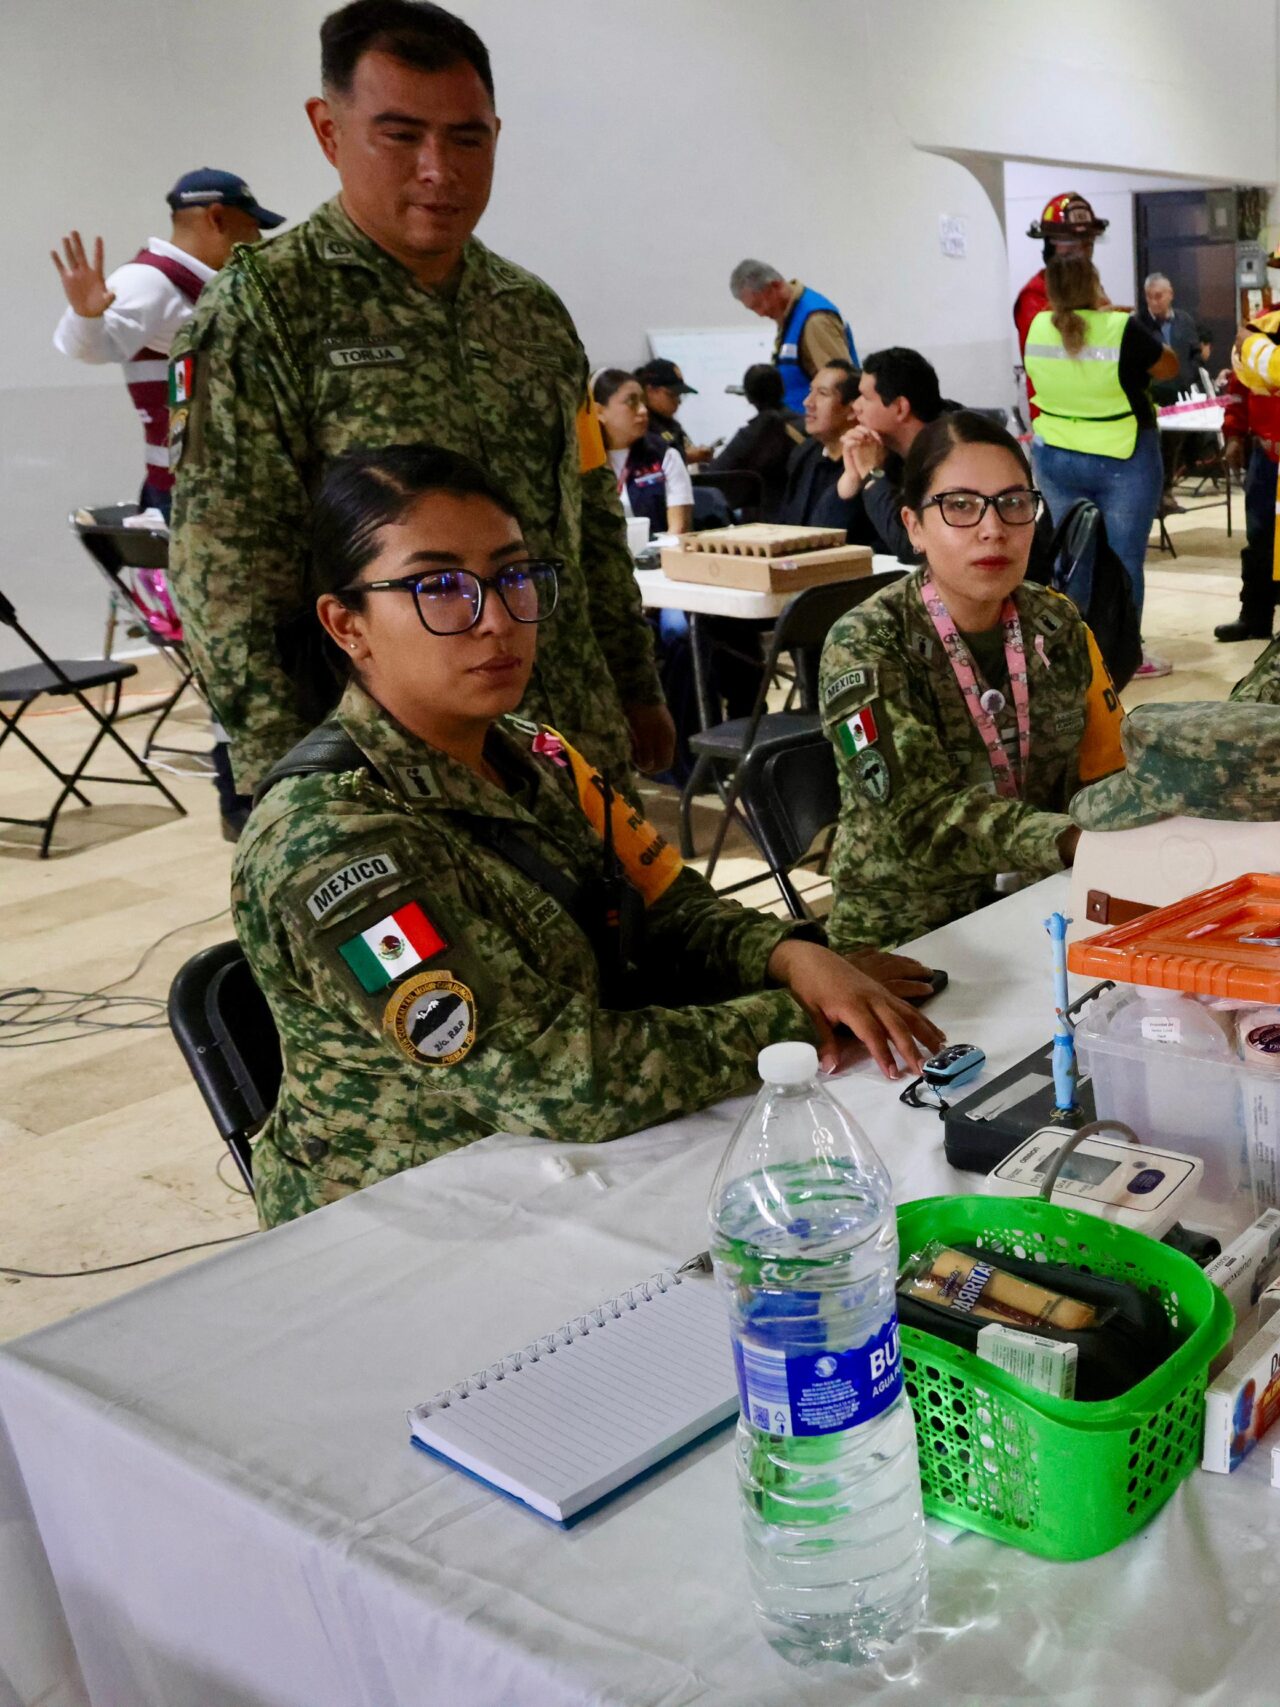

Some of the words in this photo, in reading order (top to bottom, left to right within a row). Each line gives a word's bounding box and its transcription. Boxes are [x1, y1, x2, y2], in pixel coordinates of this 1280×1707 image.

[338, 348, 396, 364] TORIJA
[827, 673, 861, 700] MEXICO
[313, 858, 389, 913] MEXICO
[869, 1331, 900, 1382] BU
[872, 1374, 895, 1398] AGUA
